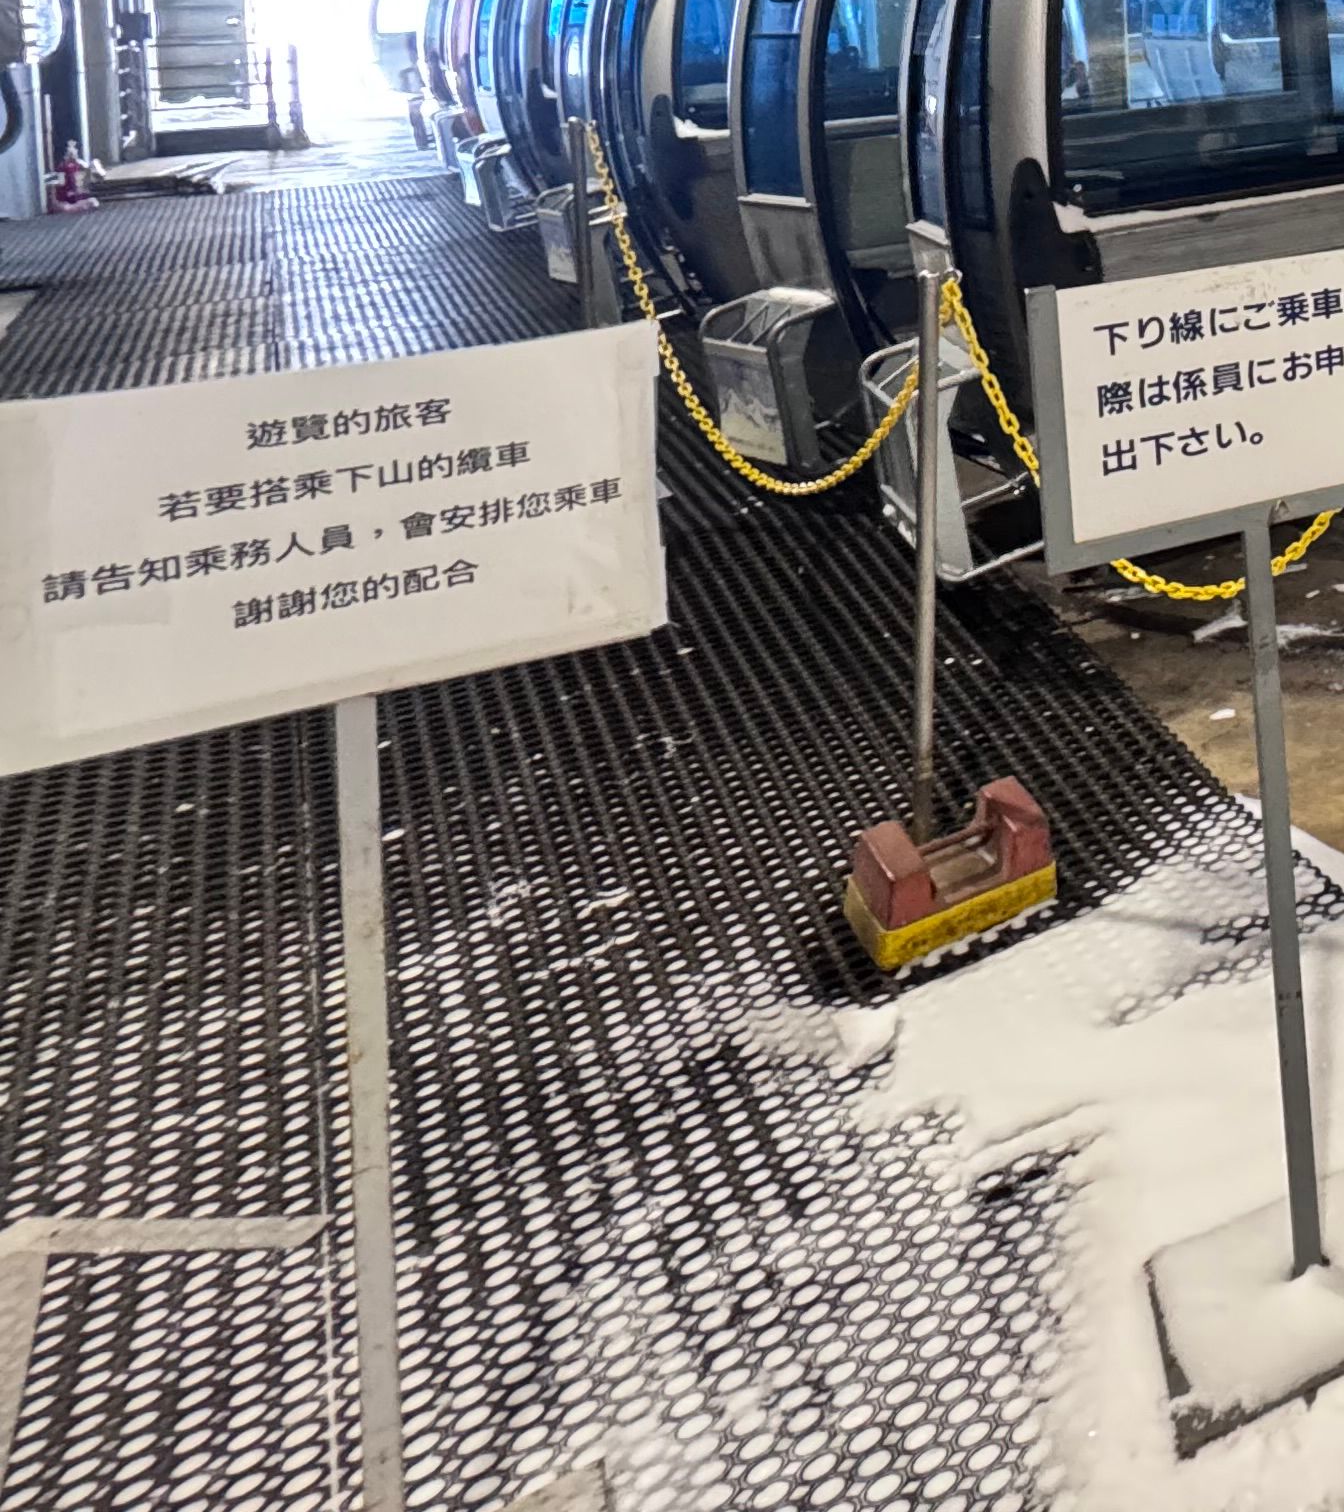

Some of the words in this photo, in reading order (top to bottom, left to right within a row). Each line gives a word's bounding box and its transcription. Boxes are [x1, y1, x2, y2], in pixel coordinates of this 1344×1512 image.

[246, 398, 452, 450] 遊覽的旅客
[1101, 421, 1265, 477] 出下さい。
[157, 441, 532, 523] 若要搭乘下山的纜車
[231, 559, 481, 630] 謝謝您的配合
